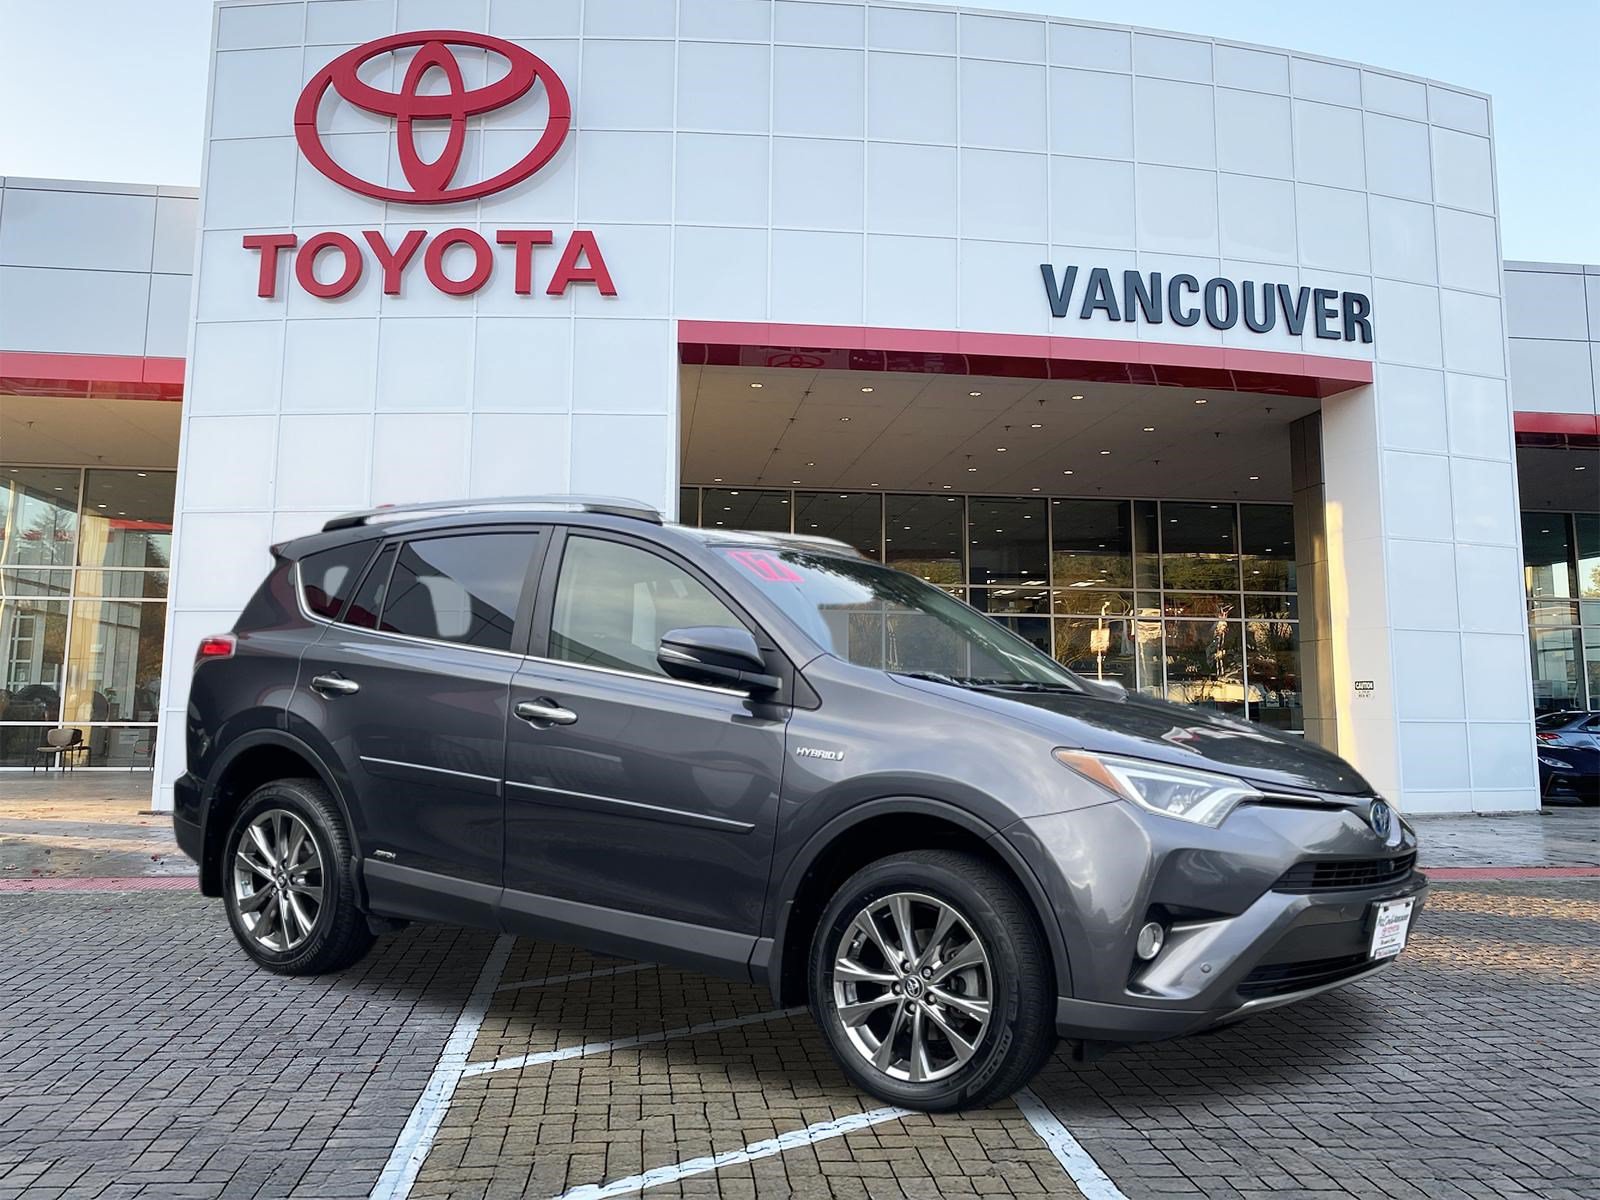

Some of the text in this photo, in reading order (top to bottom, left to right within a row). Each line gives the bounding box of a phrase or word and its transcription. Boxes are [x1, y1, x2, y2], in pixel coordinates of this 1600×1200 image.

[243, 228, 617, 298] TOYOTA
[1040, 264, 1373, 344] VANCOUVER
[796, 746, 835, 760] HYBRID
